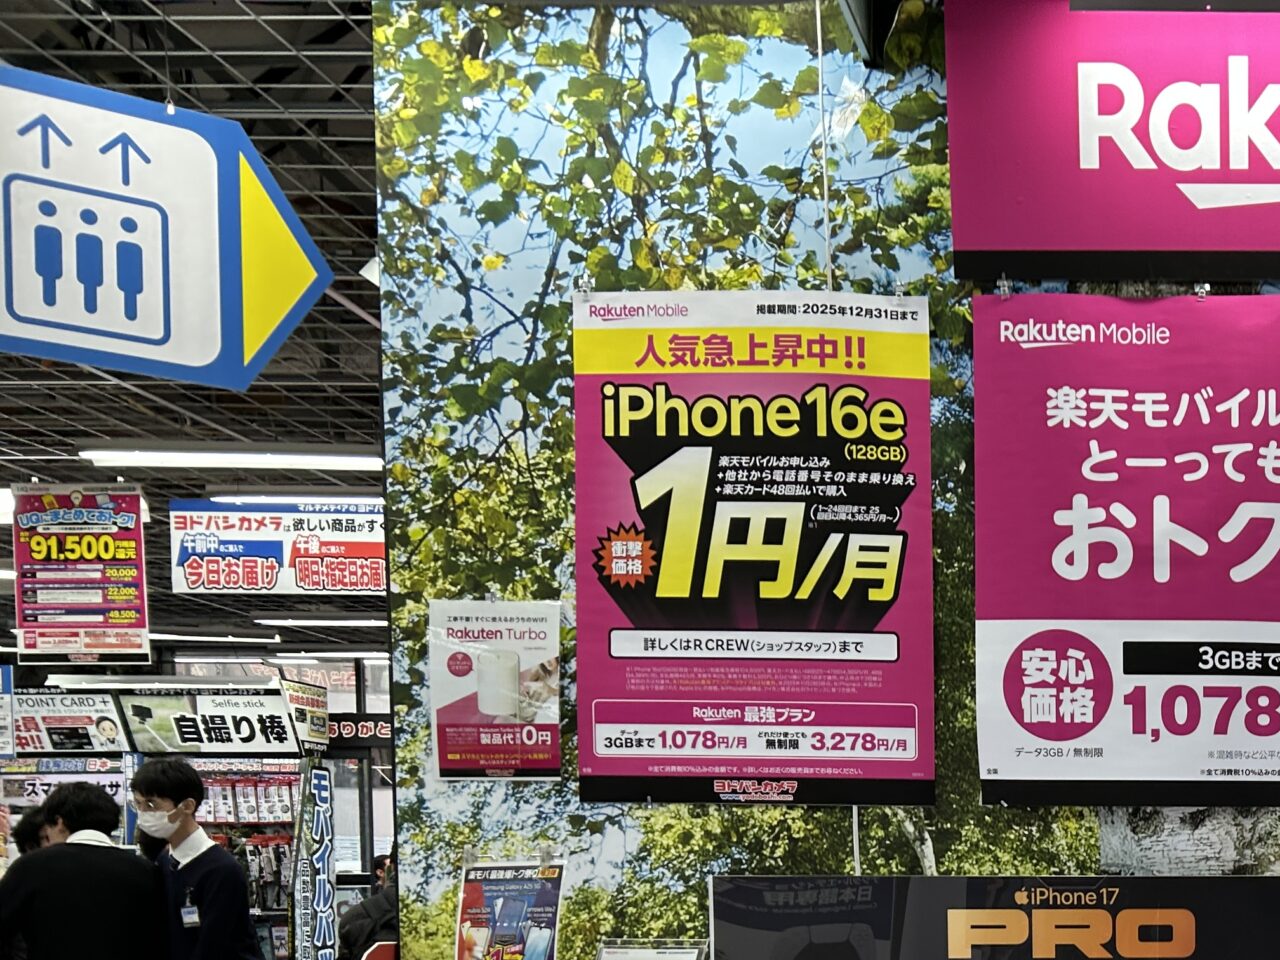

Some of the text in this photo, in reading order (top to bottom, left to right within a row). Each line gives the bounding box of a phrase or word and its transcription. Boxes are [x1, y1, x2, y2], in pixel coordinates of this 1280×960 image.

[589, 304, 688, 319] Rakuten Mobile
[1000, 320, 1170, 345] Rakuten Mobile
[635, 333, 866, 370] 人気急上昇中!!
[603, 384, 906, 440] iPhone 16e
[718, 456, 831, 467] 楽天モバイルお申し込み
[844, 443, 907, 462] (128GB)
[30, 534, 115, 560] 91,500
[610, 541, 642, 559] 衝撃
[185, 557, 280, 589] 今日お届け
[611, 558, 642, 576] 価格
[446, 627, 547, 641] Rakuten Turbo
[1021, 647, 1094, 685] 安心
[17, 697, 57, 708] POINT
[60, 697, 96, 708] CARD
[212, 699, 266, 709] Selfie stick
[1021, 686, 1095, 725] 価格
[692, 706, 815, 723] Rakuten 最強プラン
[172, 714, 288, 744] 自撮り棒
[521, 725, 551, 745] 0円
[604, 737, 655, 750] 3GBまで
[658, 730, 747, 750] 1,078円/月
[765, 739, 800, 750] 無制限
[810, 732, 908, 752] 3,278円/月
[713, 780, 798, 793] ヨドバシカメラ
[1031, 888, 1119, 906] iPhone 17
[948, 908, 1195, 958] PRO
